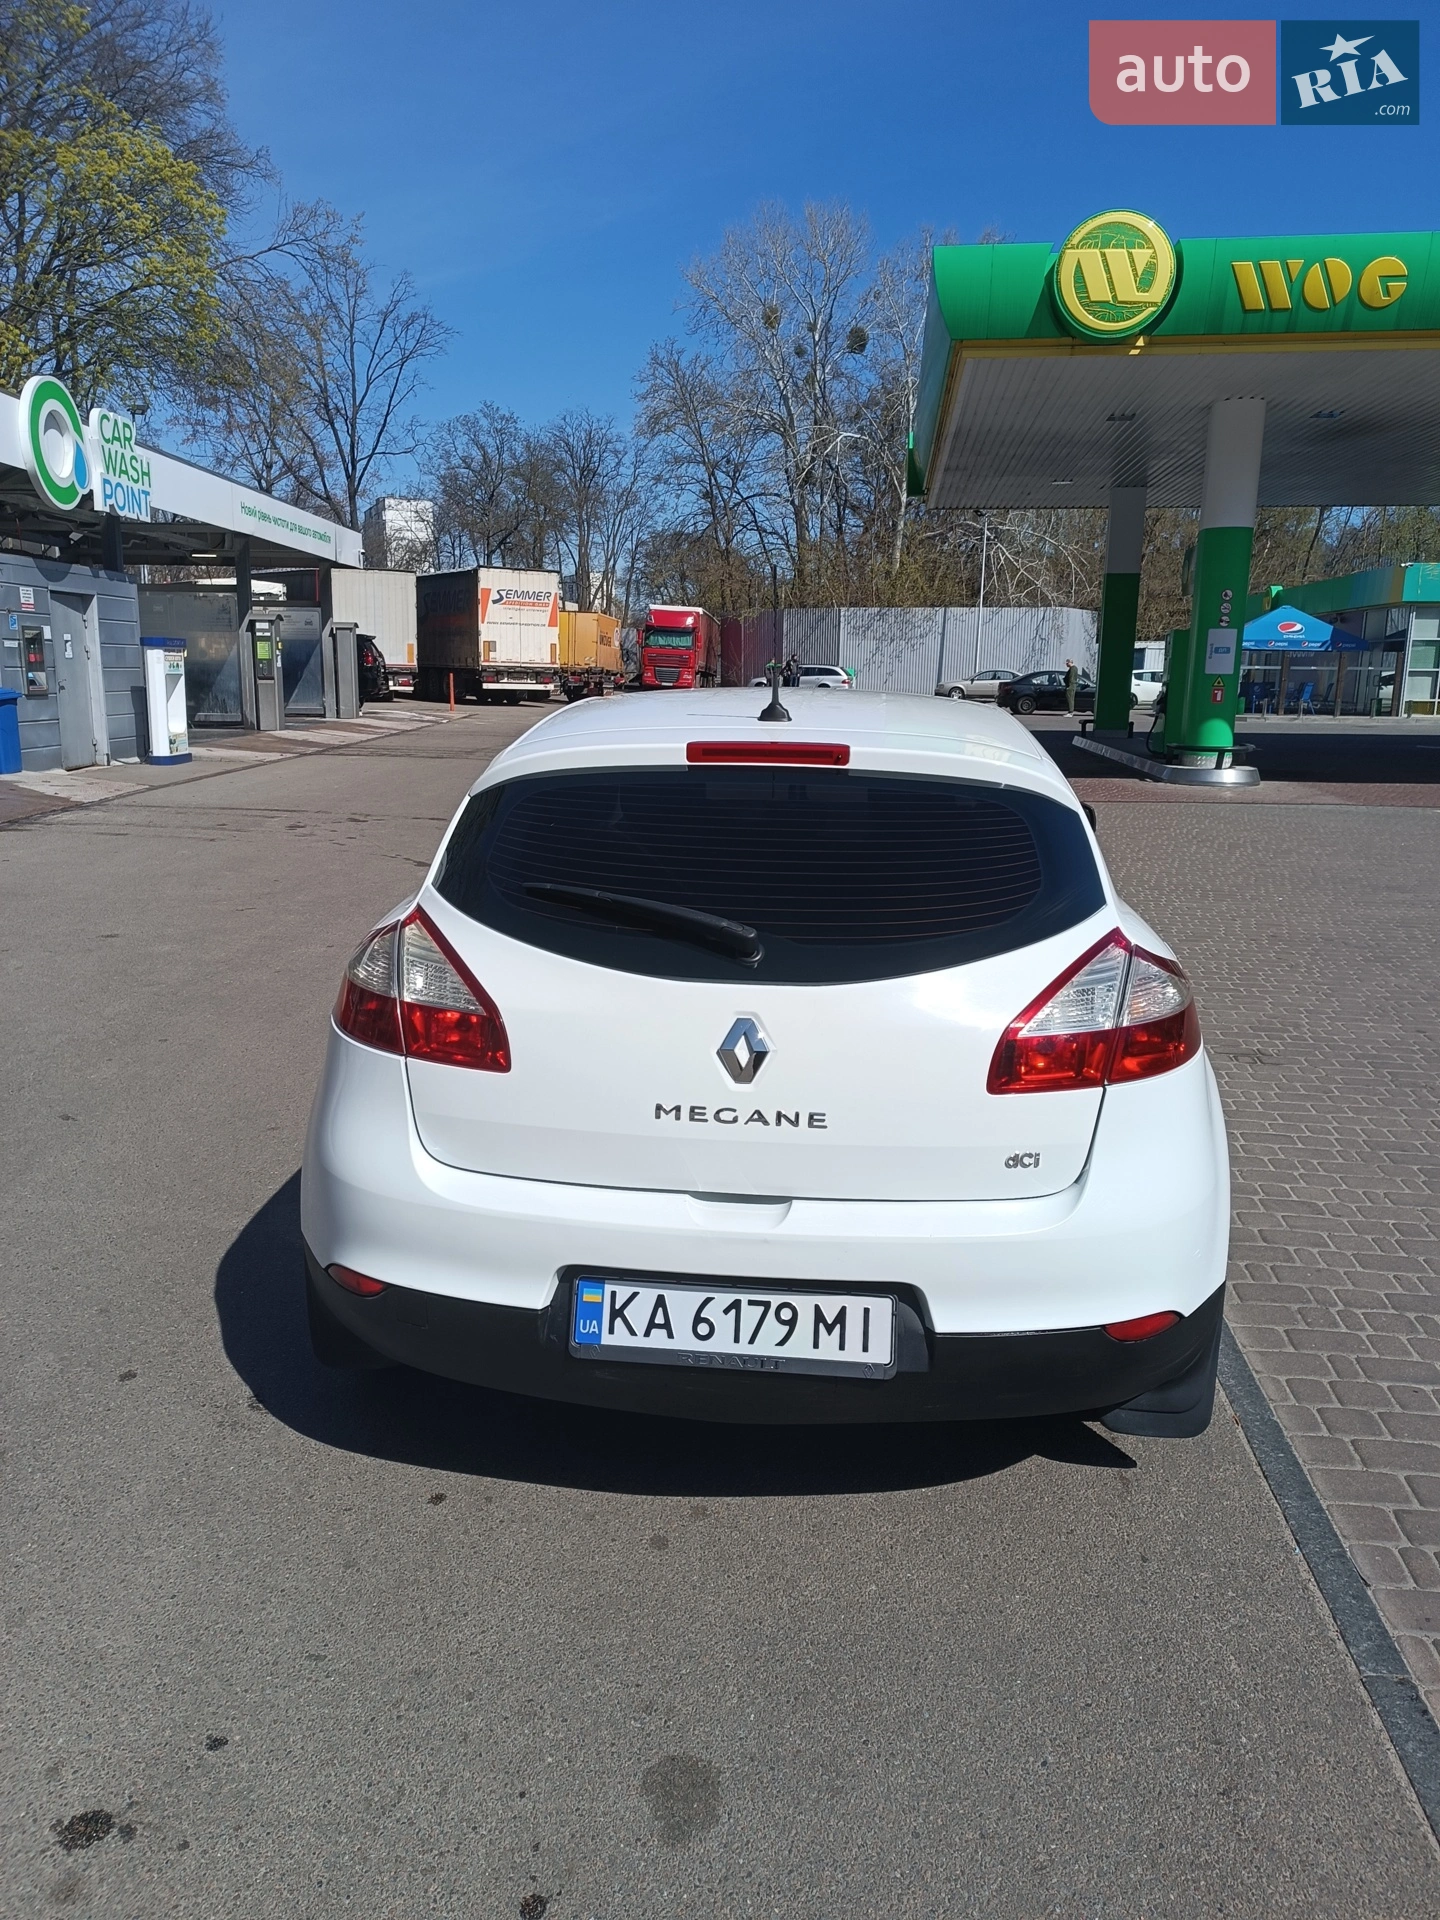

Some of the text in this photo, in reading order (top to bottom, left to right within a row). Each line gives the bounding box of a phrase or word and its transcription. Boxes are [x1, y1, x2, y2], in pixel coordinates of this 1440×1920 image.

[1231, 256, 1408, 310] WOG
[100, 413, 134, 453] CAR
[101, 445, 151, 488] WASH
[103, 478, 150, 517] POINT
[240, 501, 257, 519] Новий
[491, 589, 552, 604] SEMMER
[1214, 690, 1222, 701] 1
[655, 1103, 828, 1129] MEGANE
[1004, 1151, 1040, 1169] dCi
[579, 1290, 870, 1352] UA KA 6179 MI
[677, 1352, 787, 1370] RENAULT
